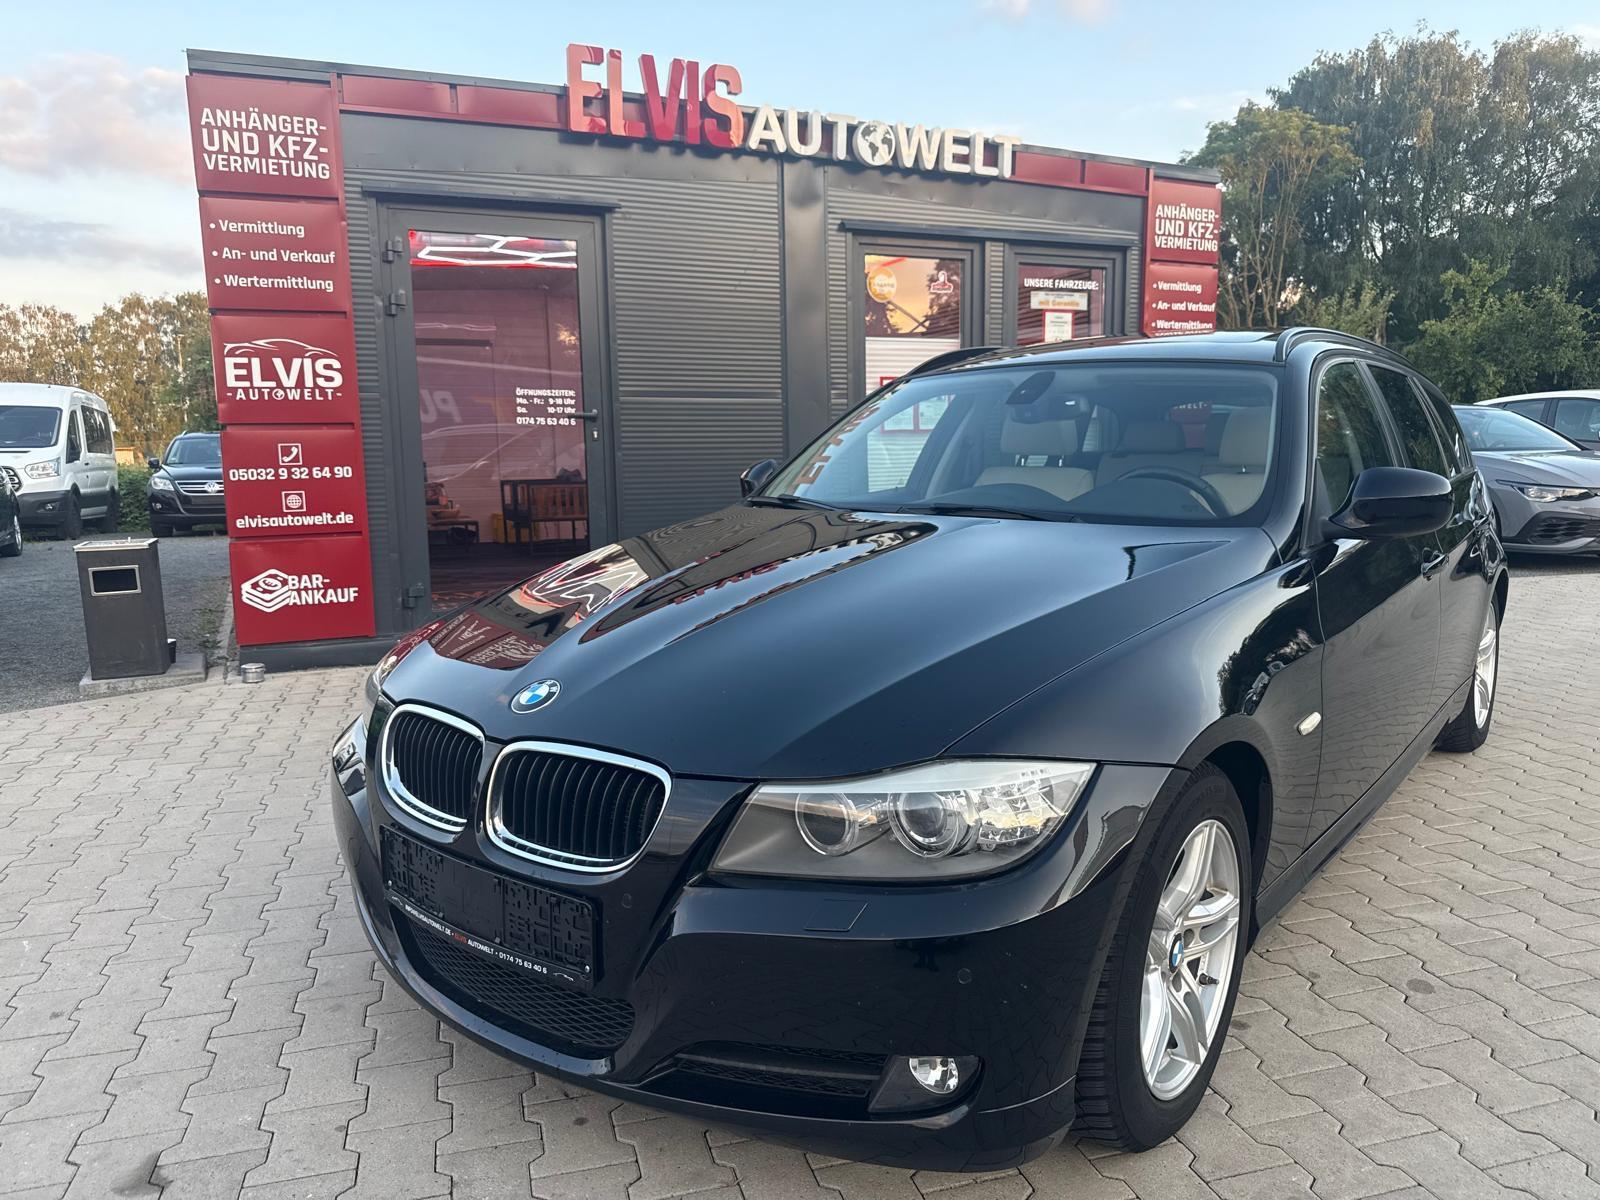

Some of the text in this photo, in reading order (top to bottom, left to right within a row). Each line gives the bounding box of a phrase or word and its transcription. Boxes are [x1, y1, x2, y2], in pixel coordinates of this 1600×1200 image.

[566, 43, 1022, 180] ELVIS AUTOWELT
[201, 107, 327, 136] ANHÄNGER-
[202, 128, 329, 160] UND KFZ-
[203, 153, 330, 179] VERMIETUNG
[1155, 203, 1219, 222] ANHÄNGER-
[219, 219, 305, 238] Vermittlung
[1155, 218, 1219, 239] UND KFZ-
[1154, 235, 1218, 252] VERMIETUNG
[222, 247, 335, 264] An- und Verkauf
[223, 274, 334, 292] Wertermittlung
[1024, 278, 1099, 290] UNSERE FAHRZEUGE:
[1158, 280, 1202, 295] Vermittlung
[1157, 300, 1216, 312] An- und Verkauf
[224, 357, 343, 388] ELVIS
[515, 387, 576, 397] ÖFFNUNGSZEITEN:
[563, 397, 576, 405] Uhr
[563, 406, 576, 414] Uhr
[516, 416, 535, 425] 0174
[535, 417, 546, 425] 75
[546, 417, 558, 426] 63
[558, 417, 569, 425] 40
[229, 466, 353, 481] 05032 9 32 64 90
[236, 511, 354, 529] elvisautowelt.de
[288, 574, 331, 590] BAR-
[288, 587, 359, 606] ANKAUF
[467, 939, 494, 955] AUTOWELT
[498, 951, 514, 963] 0174
[515, 957, 523, 966] 75
[523, 960, 533, 969] 63
[533, 964, 542, 972] 40
